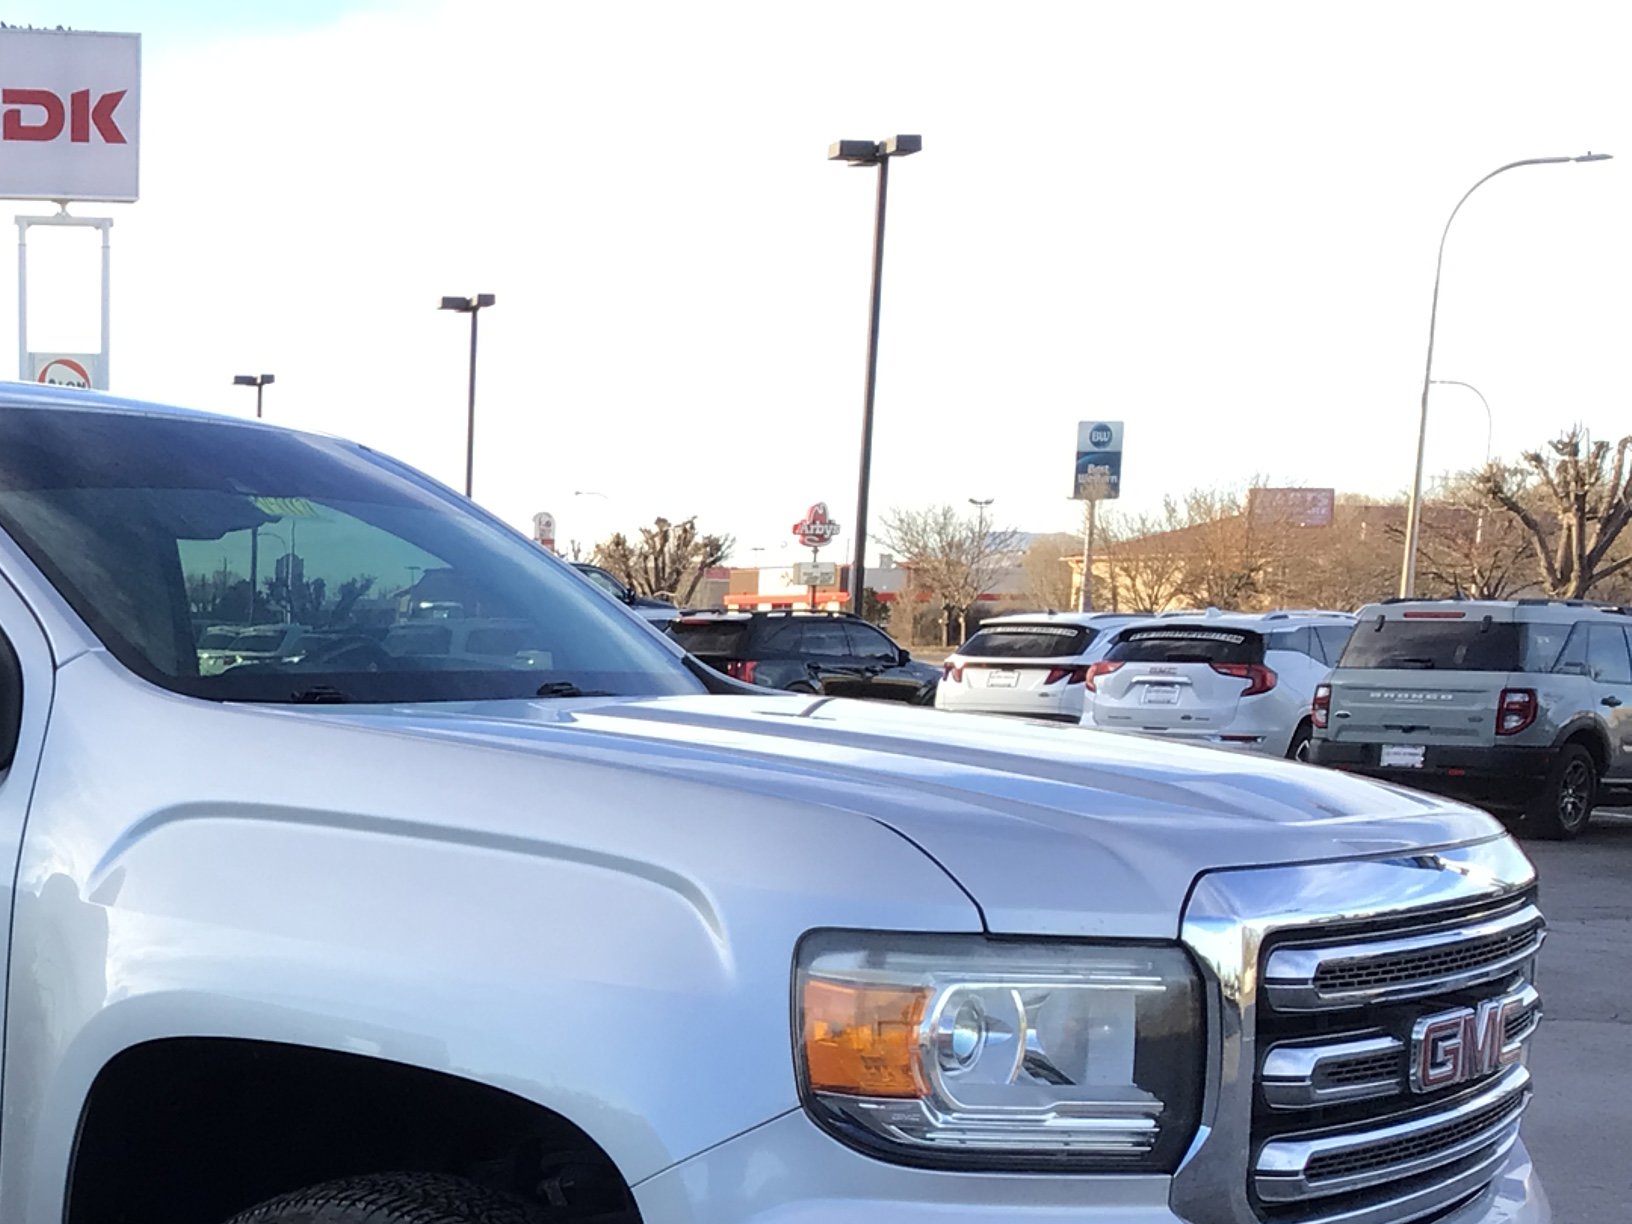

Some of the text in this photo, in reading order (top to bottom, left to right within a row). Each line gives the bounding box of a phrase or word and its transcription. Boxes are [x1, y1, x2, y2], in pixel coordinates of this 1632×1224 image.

[1, 88, 128, 144] DK
[1091, 430, 1111, 442] BW
[1411, 998, 1526, 1093] GMC
